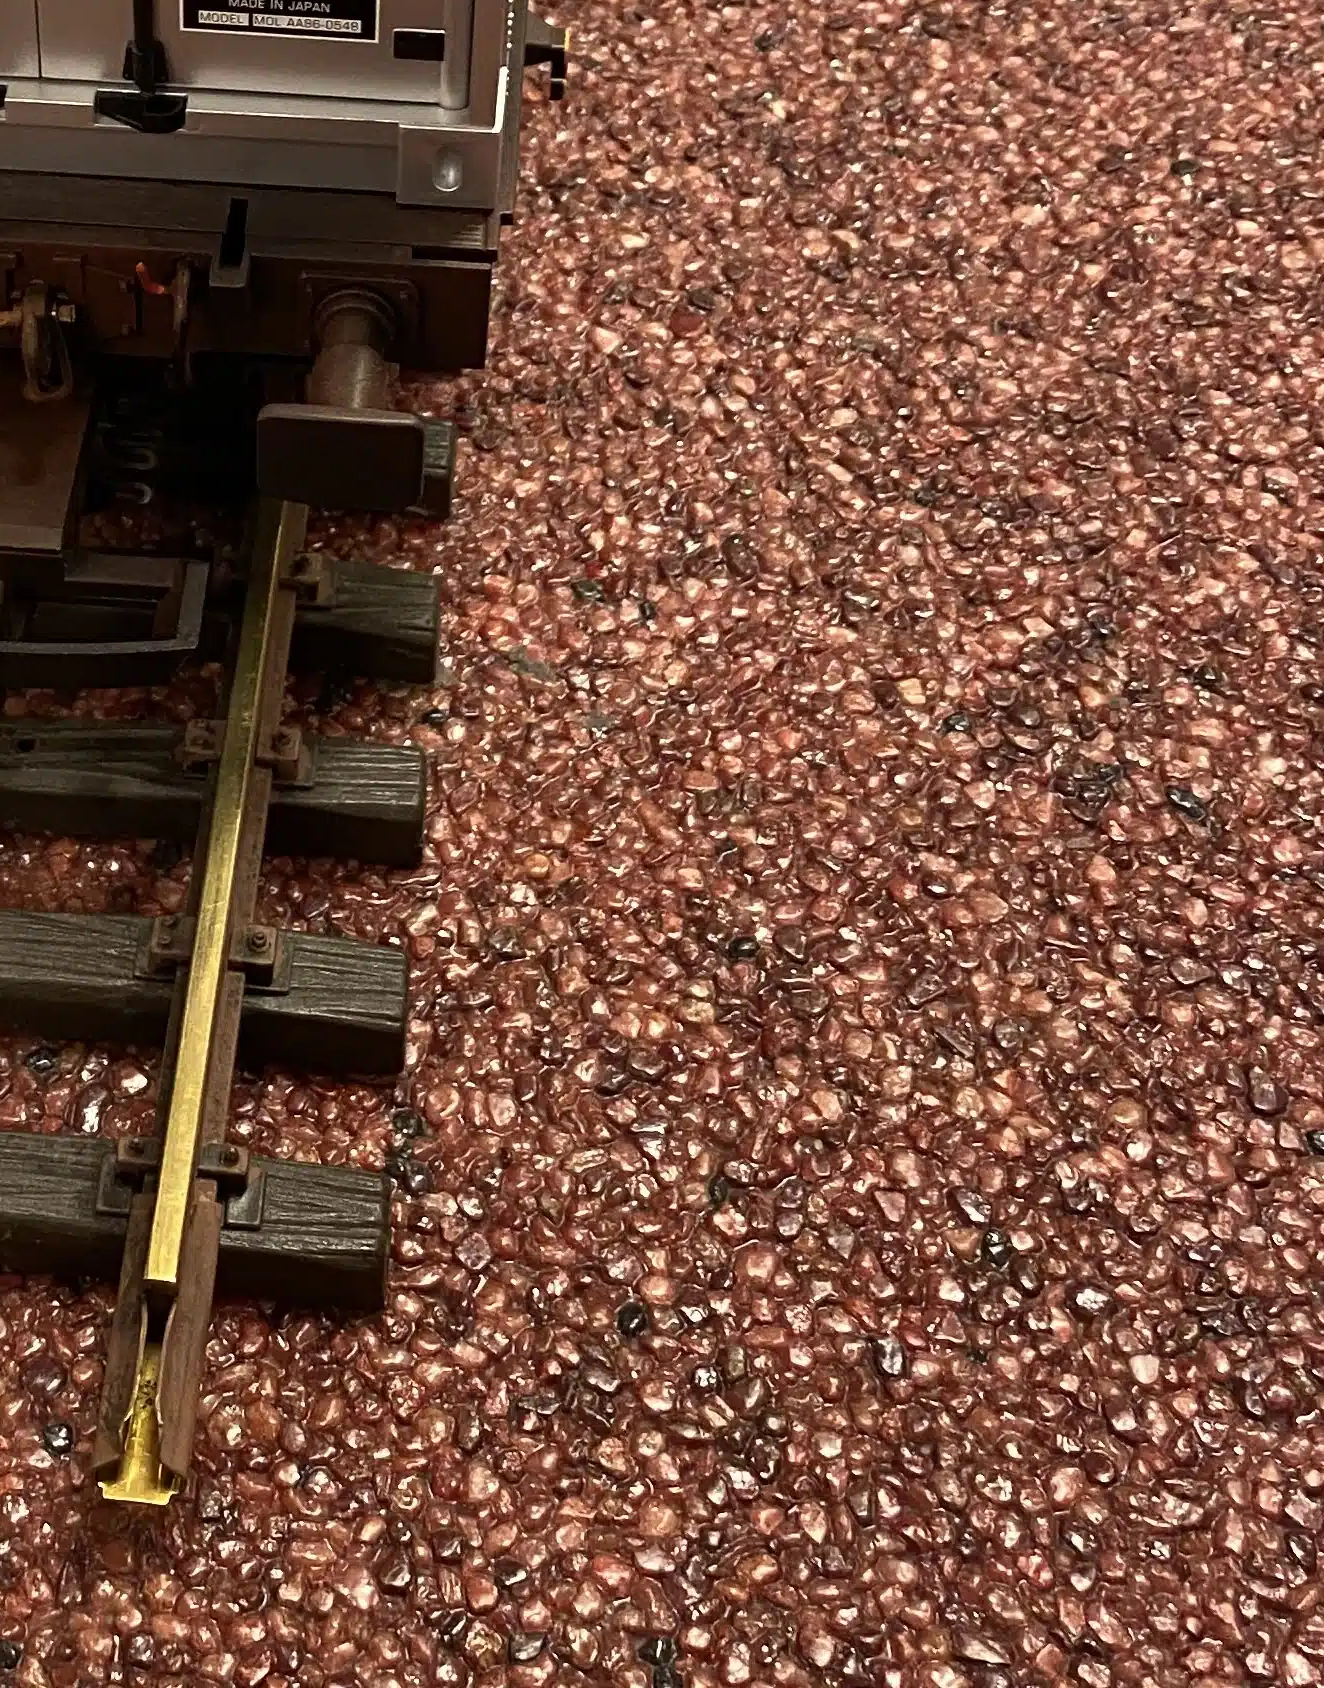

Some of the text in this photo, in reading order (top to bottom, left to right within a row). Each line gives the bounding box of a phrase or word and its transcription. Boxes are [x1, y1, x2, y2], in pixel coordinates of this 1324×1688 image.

[270, 0, 284, 10] IN
[288, 1, 330, 13] JAPAN
[200, 12, 244, 24] MODEL
[254, 15, 281, 26] MOL
